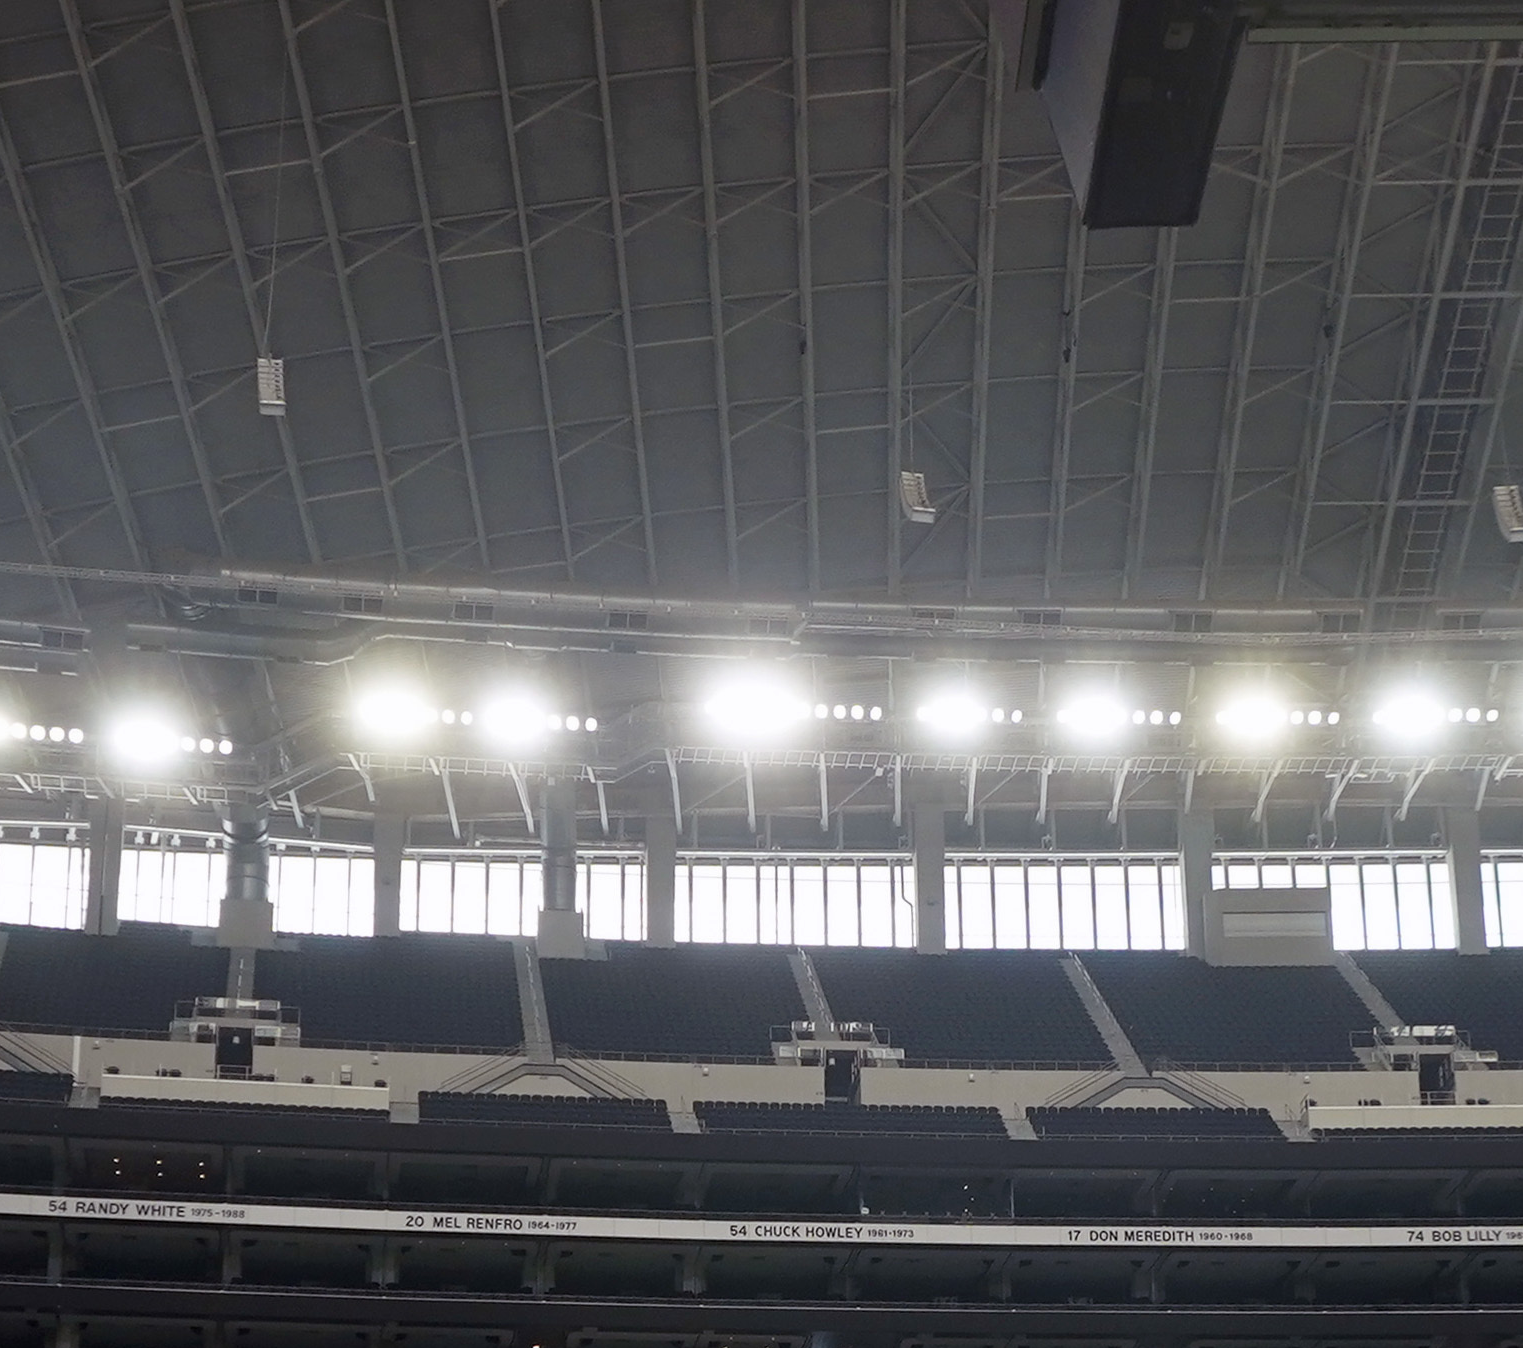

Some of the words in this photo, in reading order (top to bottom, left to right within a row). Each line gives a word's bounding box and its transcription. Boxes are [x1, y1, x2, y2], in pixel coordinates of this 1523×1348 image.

[48, 1200, 67, 1213] 54
[75, 1201, 130, 1216] RANDY
[136, 1204, 186, 1218] WHITE
[405, 1215, 425, 1227] 20
[433, 1216, 462, 1229] MEL
[466, 1217, 523, 1231] RENFRO
[527, 1221, 577, 1231] 1964-1977
[729, 1225, 747, 1237] 54
[755, 1225, 801, 1238] CHUCK
[805, 1226, 863, 1239] HOWLEY
[1067, 1230, 1081, 1242] 17
[1089, 1230, 1118, 1242] DON
[1124, 1230, 1195, 1242] MEREDITH
[1407, 1230, 1424, 1242] 74
[1432, 1230, 1462, 1243] BOB
[1466, 1230, 1503, 1242] LILLY
